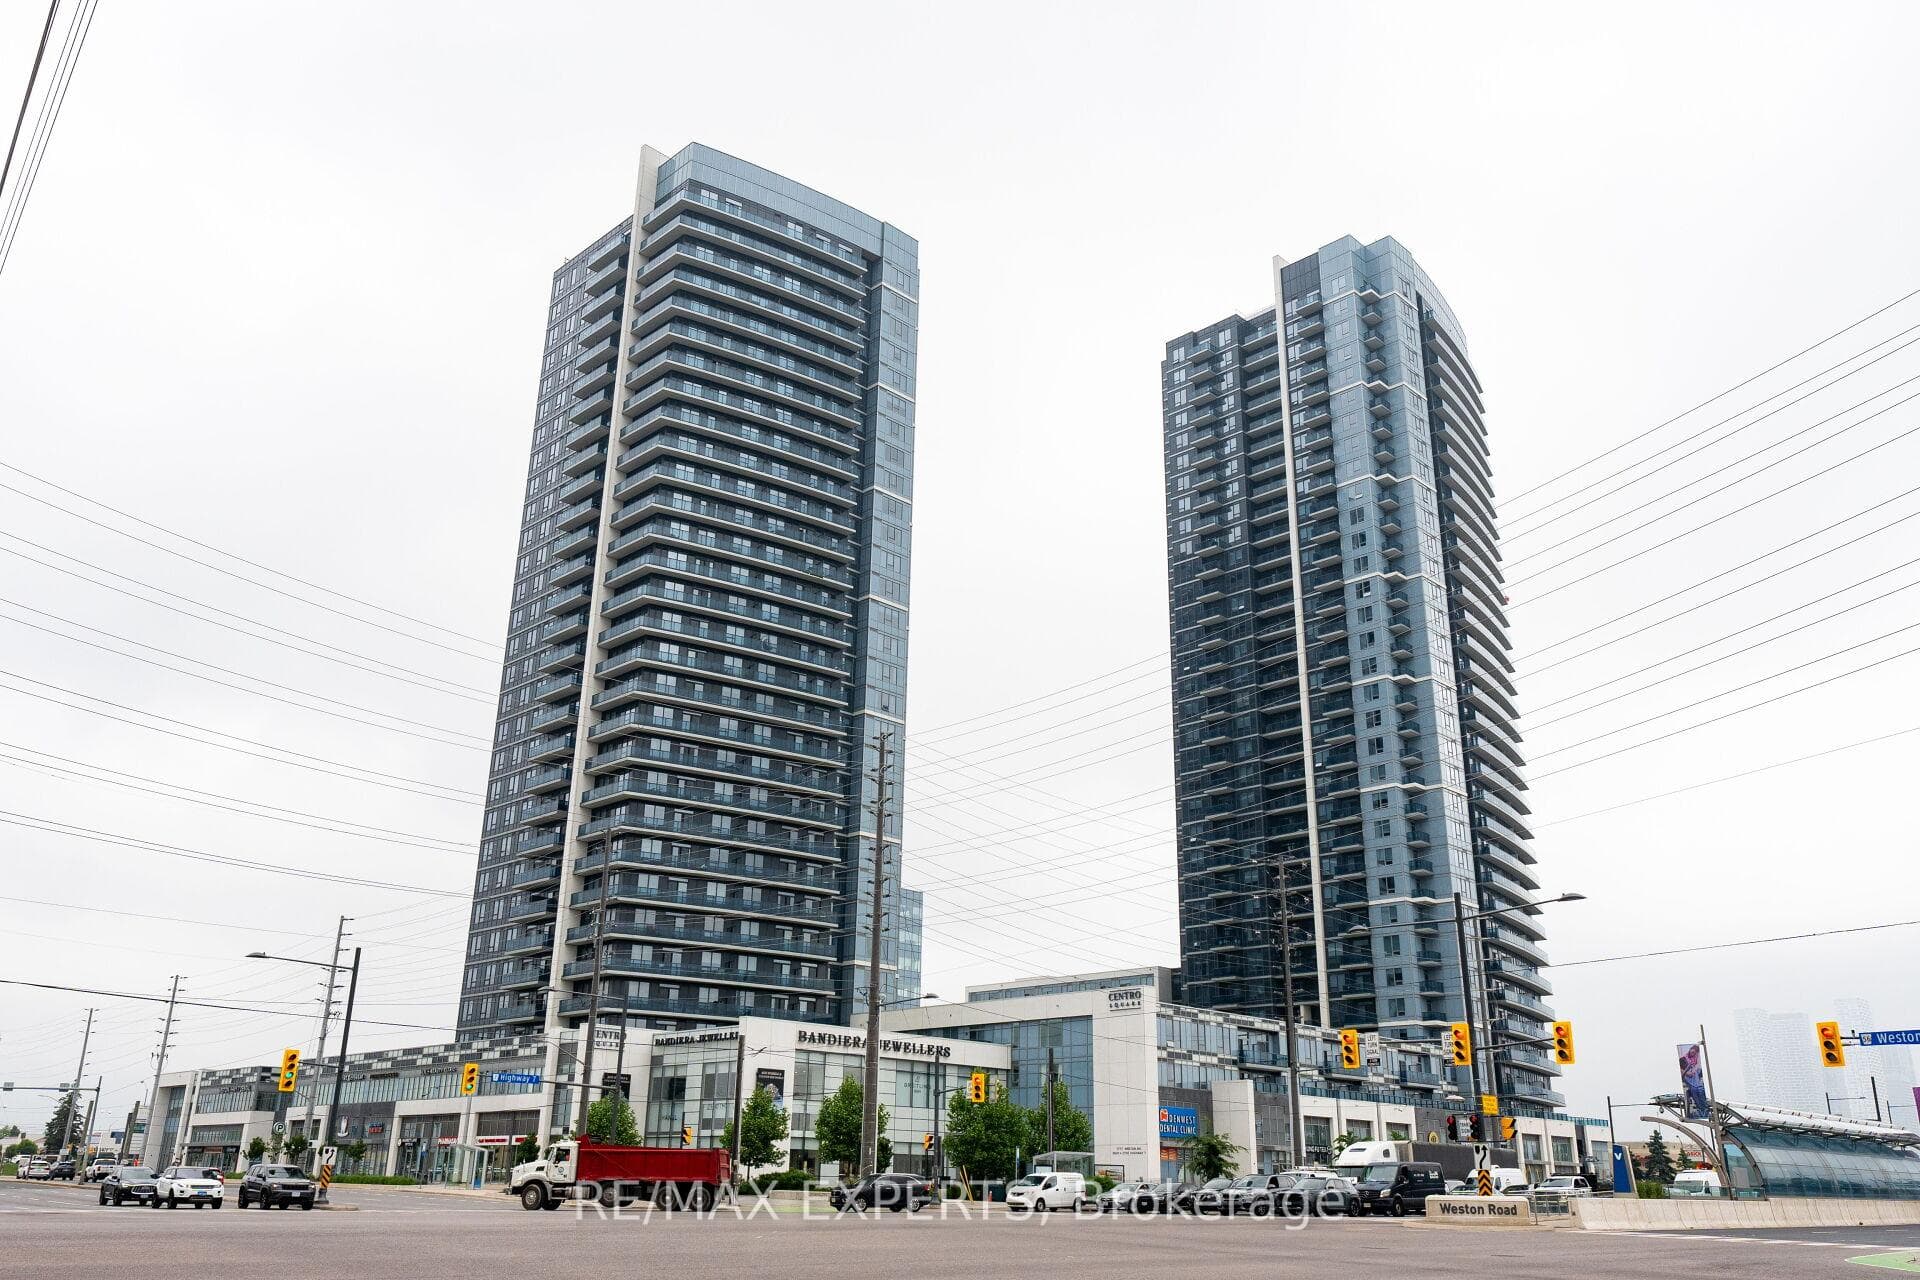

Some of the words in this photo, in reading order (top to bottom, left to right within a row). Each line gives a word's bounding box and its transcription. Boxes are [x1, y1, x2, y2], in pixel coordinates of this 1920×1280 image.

[1108, 990, 1142, 1001] CENTRO
[655, 1035, 694, 1046] BANDIERA
[500, 1074, 530, 1084] Highway
[1159, 1123, 1179, 1134] DENTAL
[1180, 1125, 1197, 1135] CLINIC
[1440, 1203, 1485, 1215] Weston
[1488, 1204, 1518, 1216] Road
